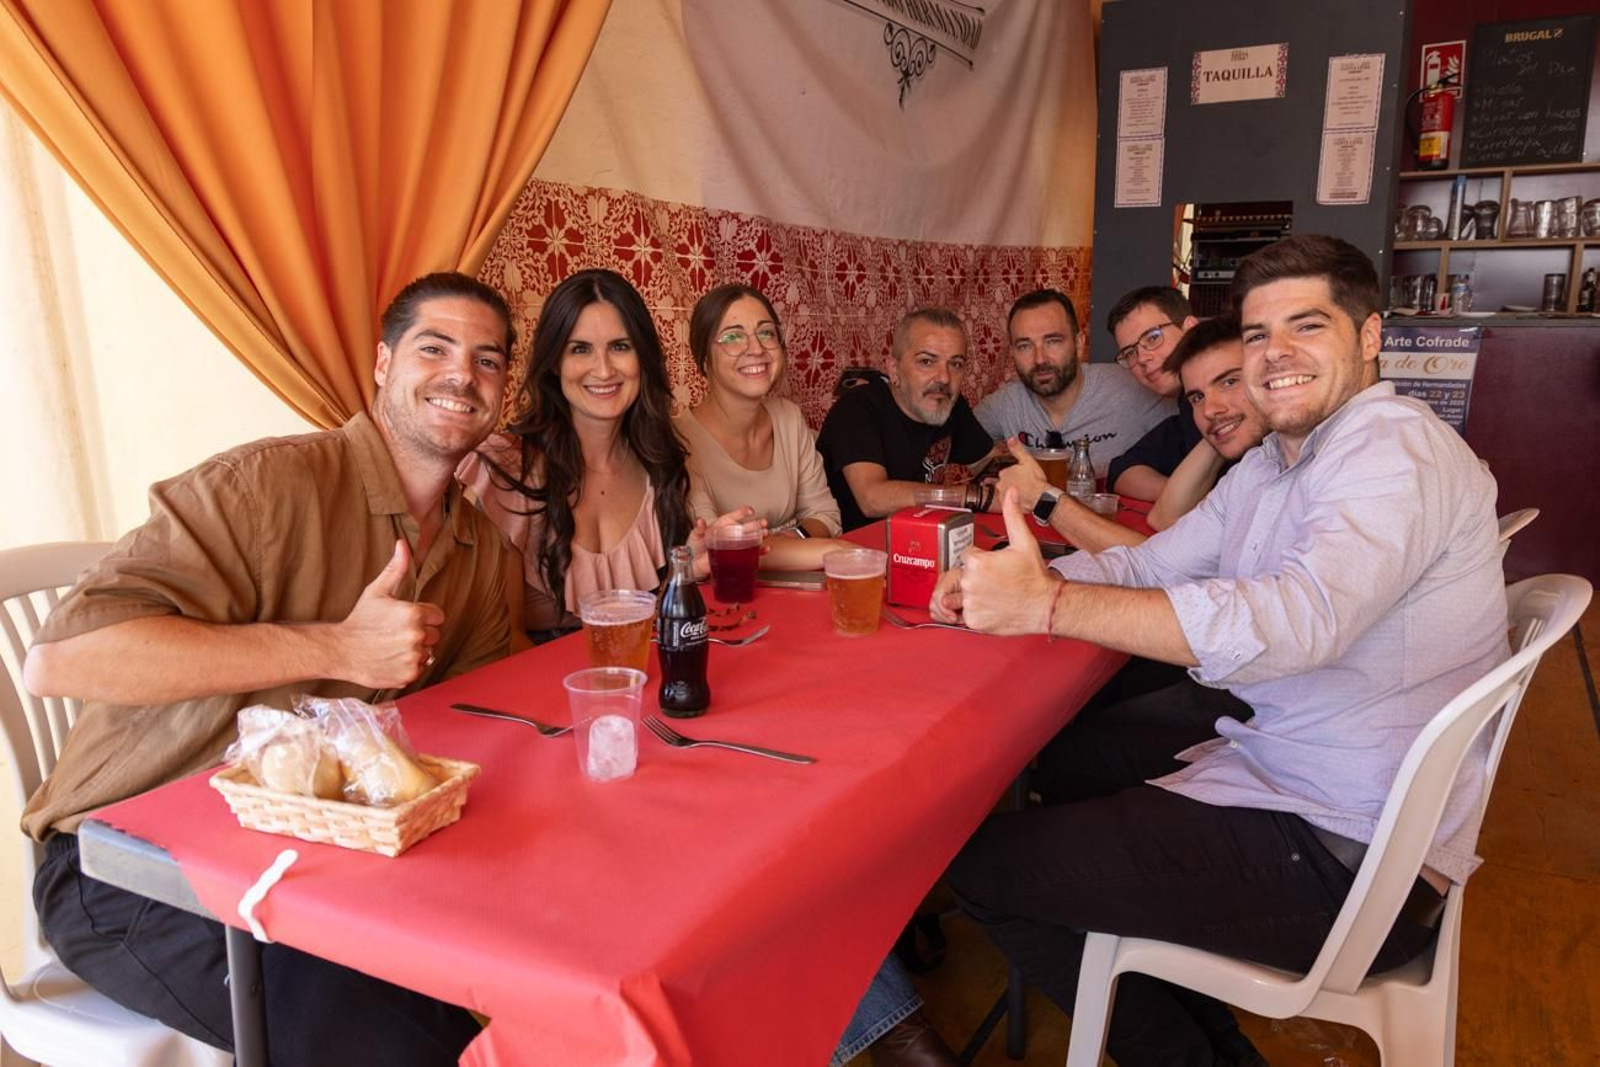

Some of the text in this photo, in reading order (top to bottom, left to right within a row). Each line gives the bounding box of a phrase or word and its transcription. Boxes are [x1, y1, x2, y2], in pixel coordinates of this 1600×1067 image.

[1505, 30, 1552, 42] BRUGAL
[1203, 65, 1273, 82] TAQUILLA
[1384, 336, 1470, 348] Arte Cofrade
[1423, 356, 1468, 374] Oro
[893, 553, 935, 569] Cruzcampo
